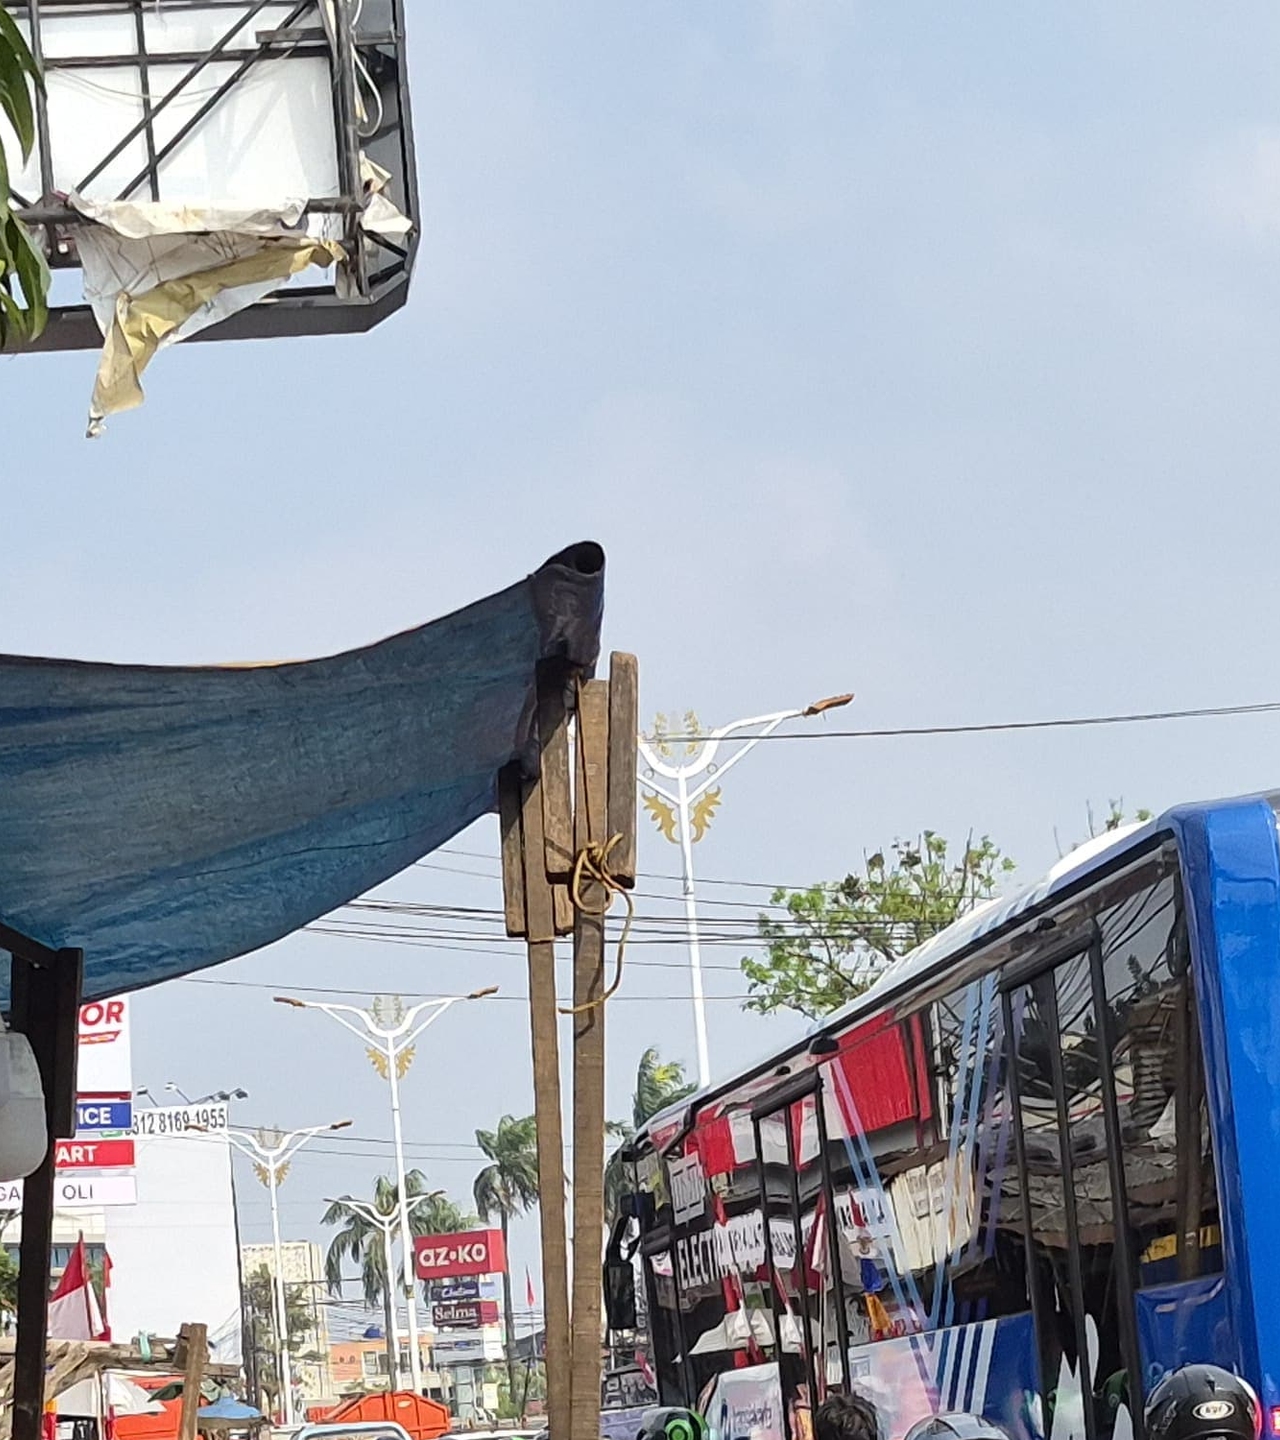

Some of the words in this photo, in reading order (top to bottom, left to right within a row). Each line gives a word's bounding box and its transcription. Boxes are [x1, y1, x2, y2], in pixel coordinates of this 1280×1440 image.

[81, 1000, 125, 1026] OR
[78, 1107, 112, 1126] ICE
[56, 1145, 98, 1163] ART
[434, 1305, 477, 1321] Selma
